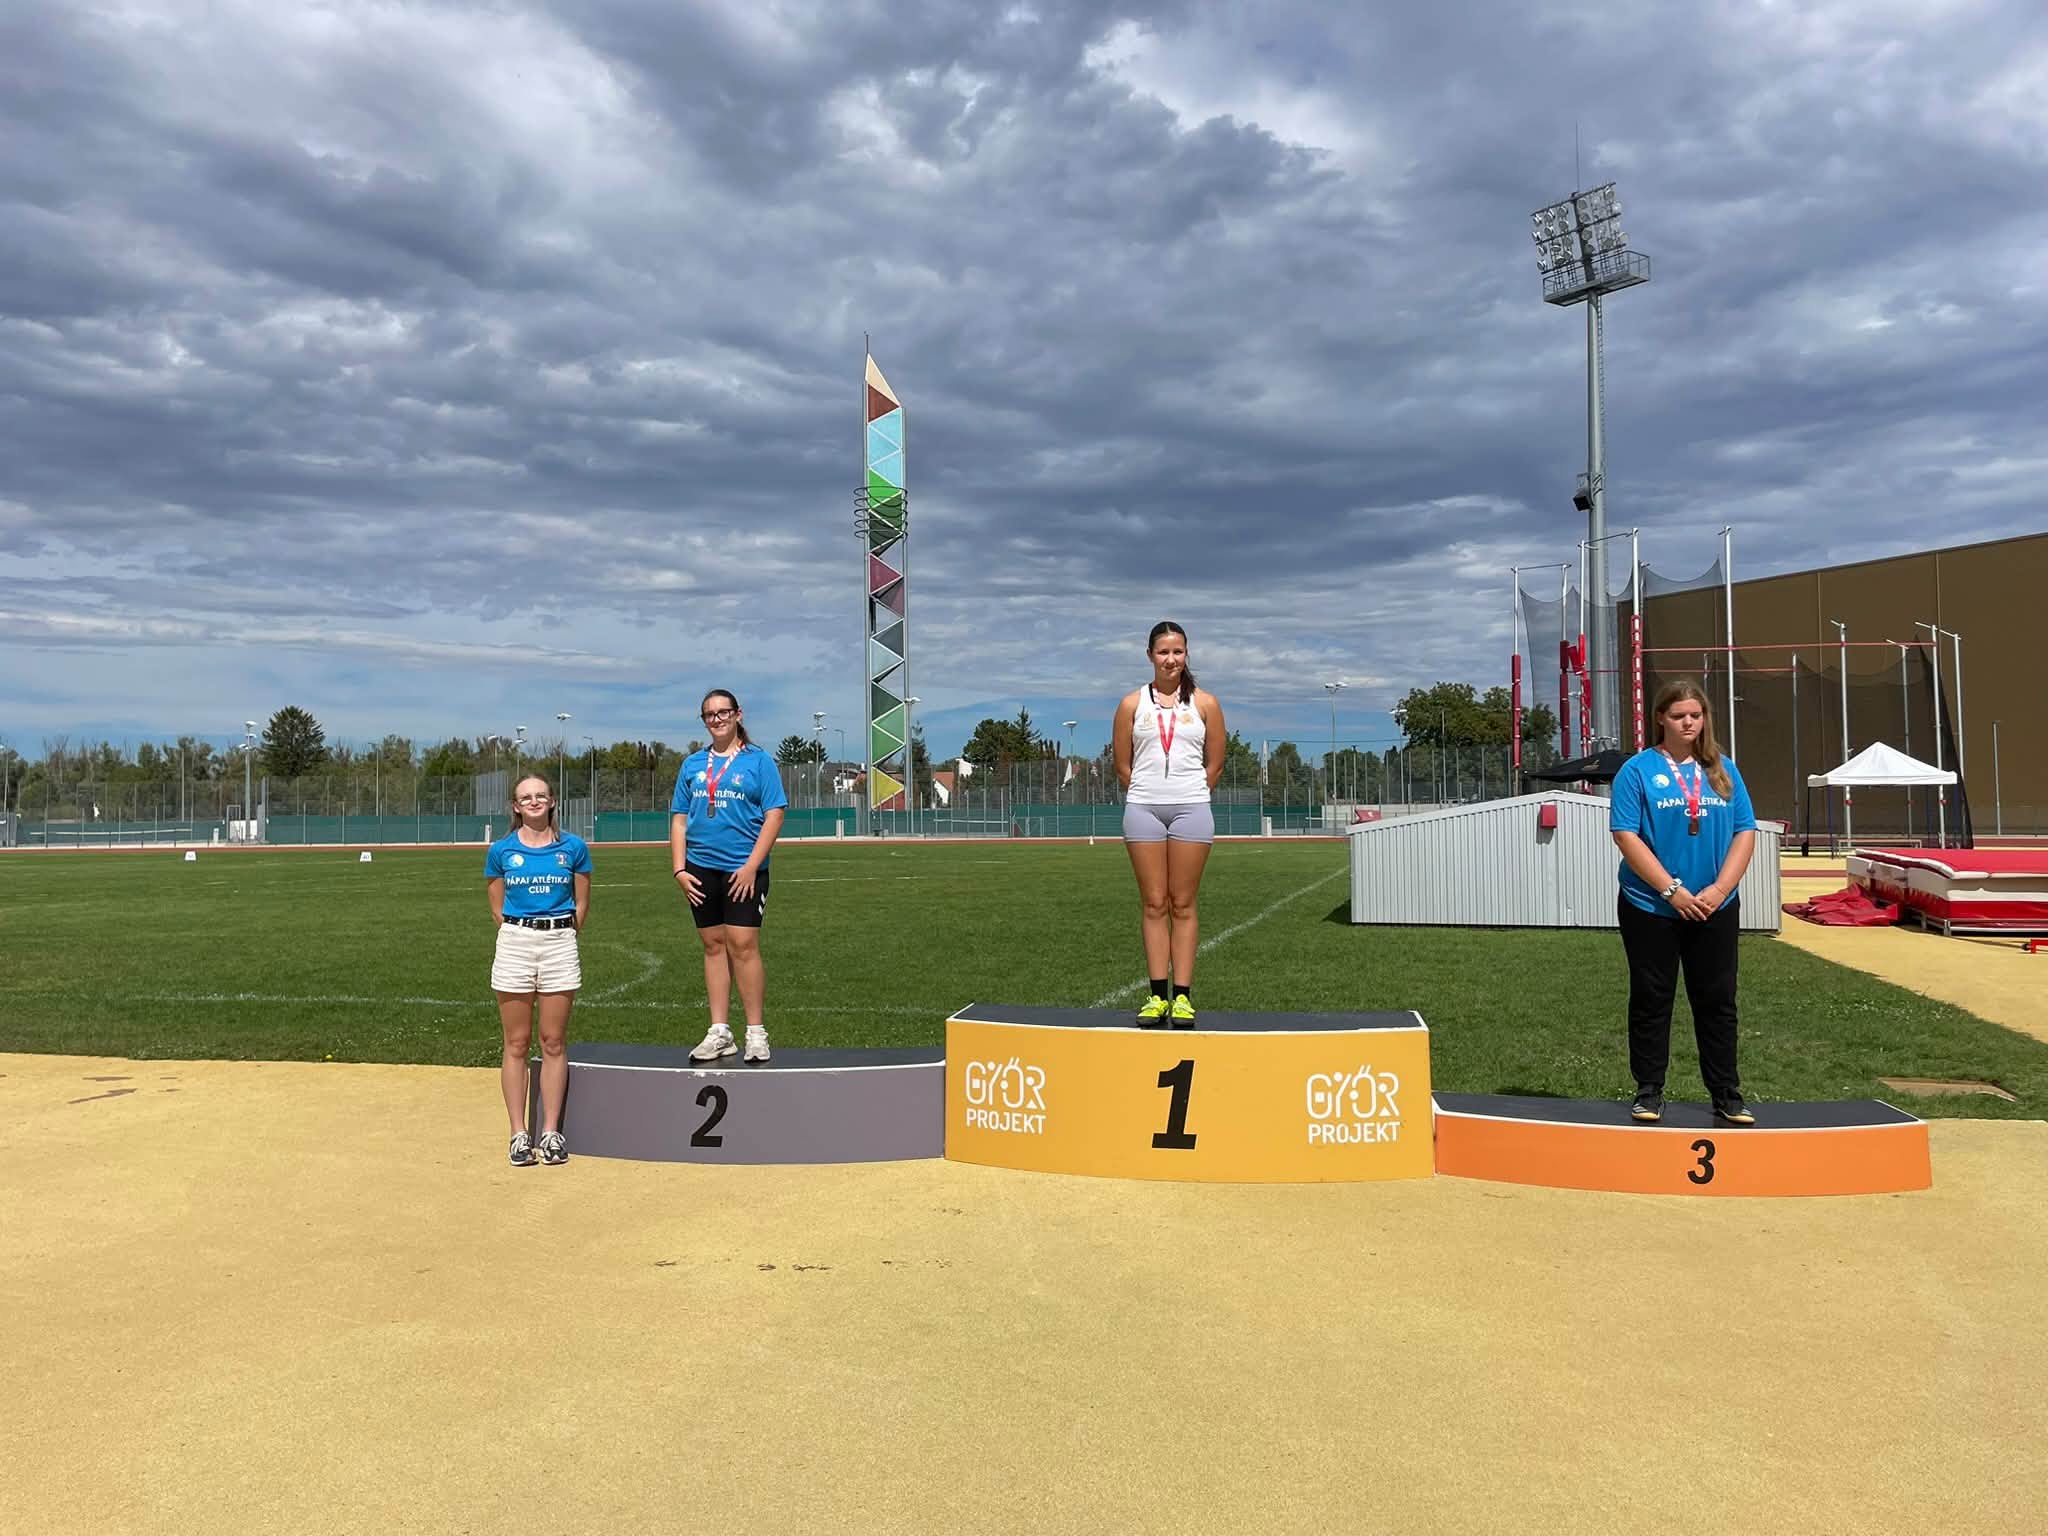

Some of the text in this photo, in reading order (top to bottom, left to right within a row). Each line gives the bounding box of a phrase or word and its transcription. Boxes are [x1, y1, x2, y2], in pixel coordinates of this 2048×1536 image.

[692, 788, 710, 798] PÁPA
[714, 800, 728, 808] LUB
[1657, 796, 1727, 809] PÁPAI LÉTIKAI
[1684, 808, 1708, 817] CUB
[506, 875, 530, 886] PÁPAI
[528, 886, 551, 894] CLUB
[965, 1056, 1047, 1111] GYŐR
[1306, 1064, 1401, 1120] GYŐR
[690, 1085, 728, 1147] 2
[1152, 1059, 1198, 1150] 1
[966, 1107, 1047, 1135] PROJEKT
[1307, 1121, 1402, 1145] PROJEKT
[1687, 1138, 1716, 1185] 3
